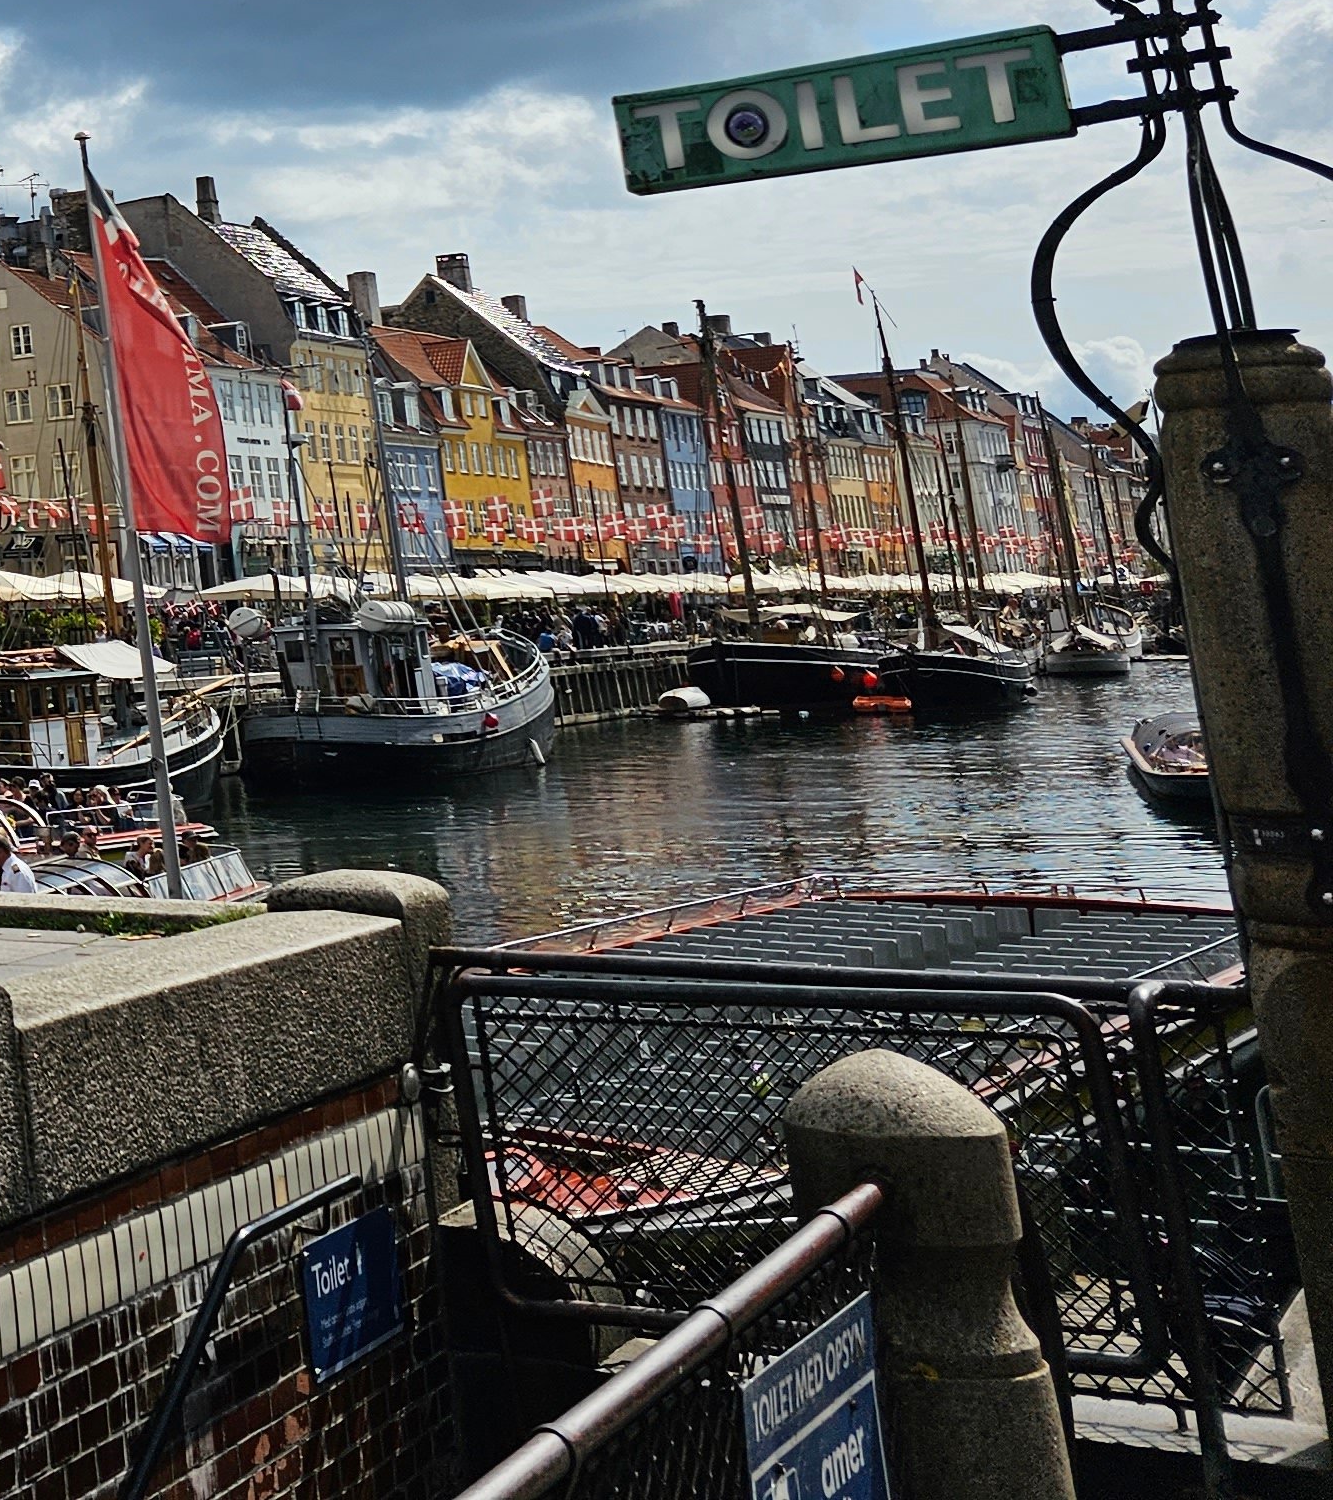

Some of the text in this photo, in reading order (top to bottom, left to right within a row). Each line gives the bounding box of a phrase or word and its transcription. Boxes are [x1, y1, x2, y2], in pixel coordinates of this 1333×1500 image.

[634, 48, 1032, 169] TOILET
[311, 1255, 352, 1298] Toilet
[795, 1352, 823, 1409] MED
[825, 1316, 866, 1382] OPSYN
